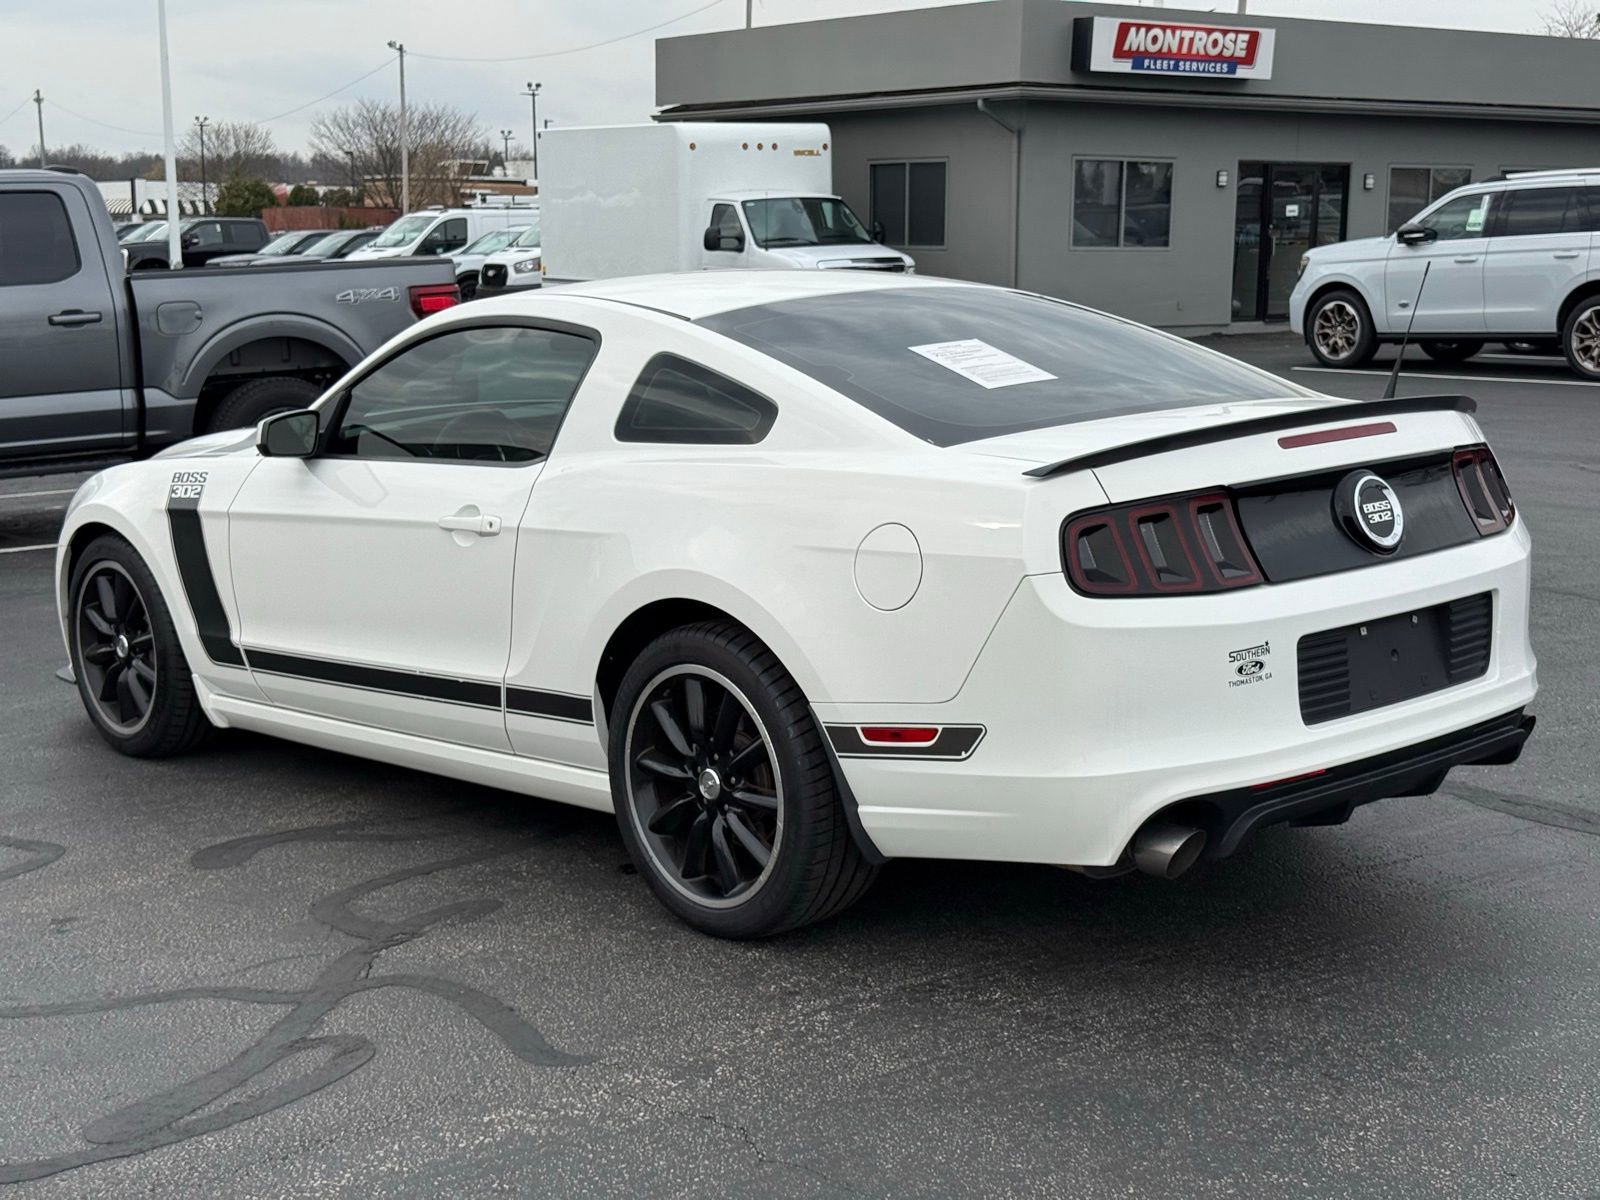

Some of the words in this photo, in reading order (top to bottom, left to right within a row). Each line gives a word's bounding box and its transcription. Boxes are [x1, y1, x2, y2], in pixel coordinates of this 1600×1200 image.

[1123, 26, 1250, 58] MONTROSE
[1143, 58, 1174, 70] FLEET
[1178, 61, 1228, 73] SERVICES
[172, 471, 209, 483] BOSS
[171, 485, 202, 498] 302
[1362, 500, 1391, 514] BOSS
[1367, 510, 1393, 524] 302
[1228, 644, 1271, 663] SOUTHERN
